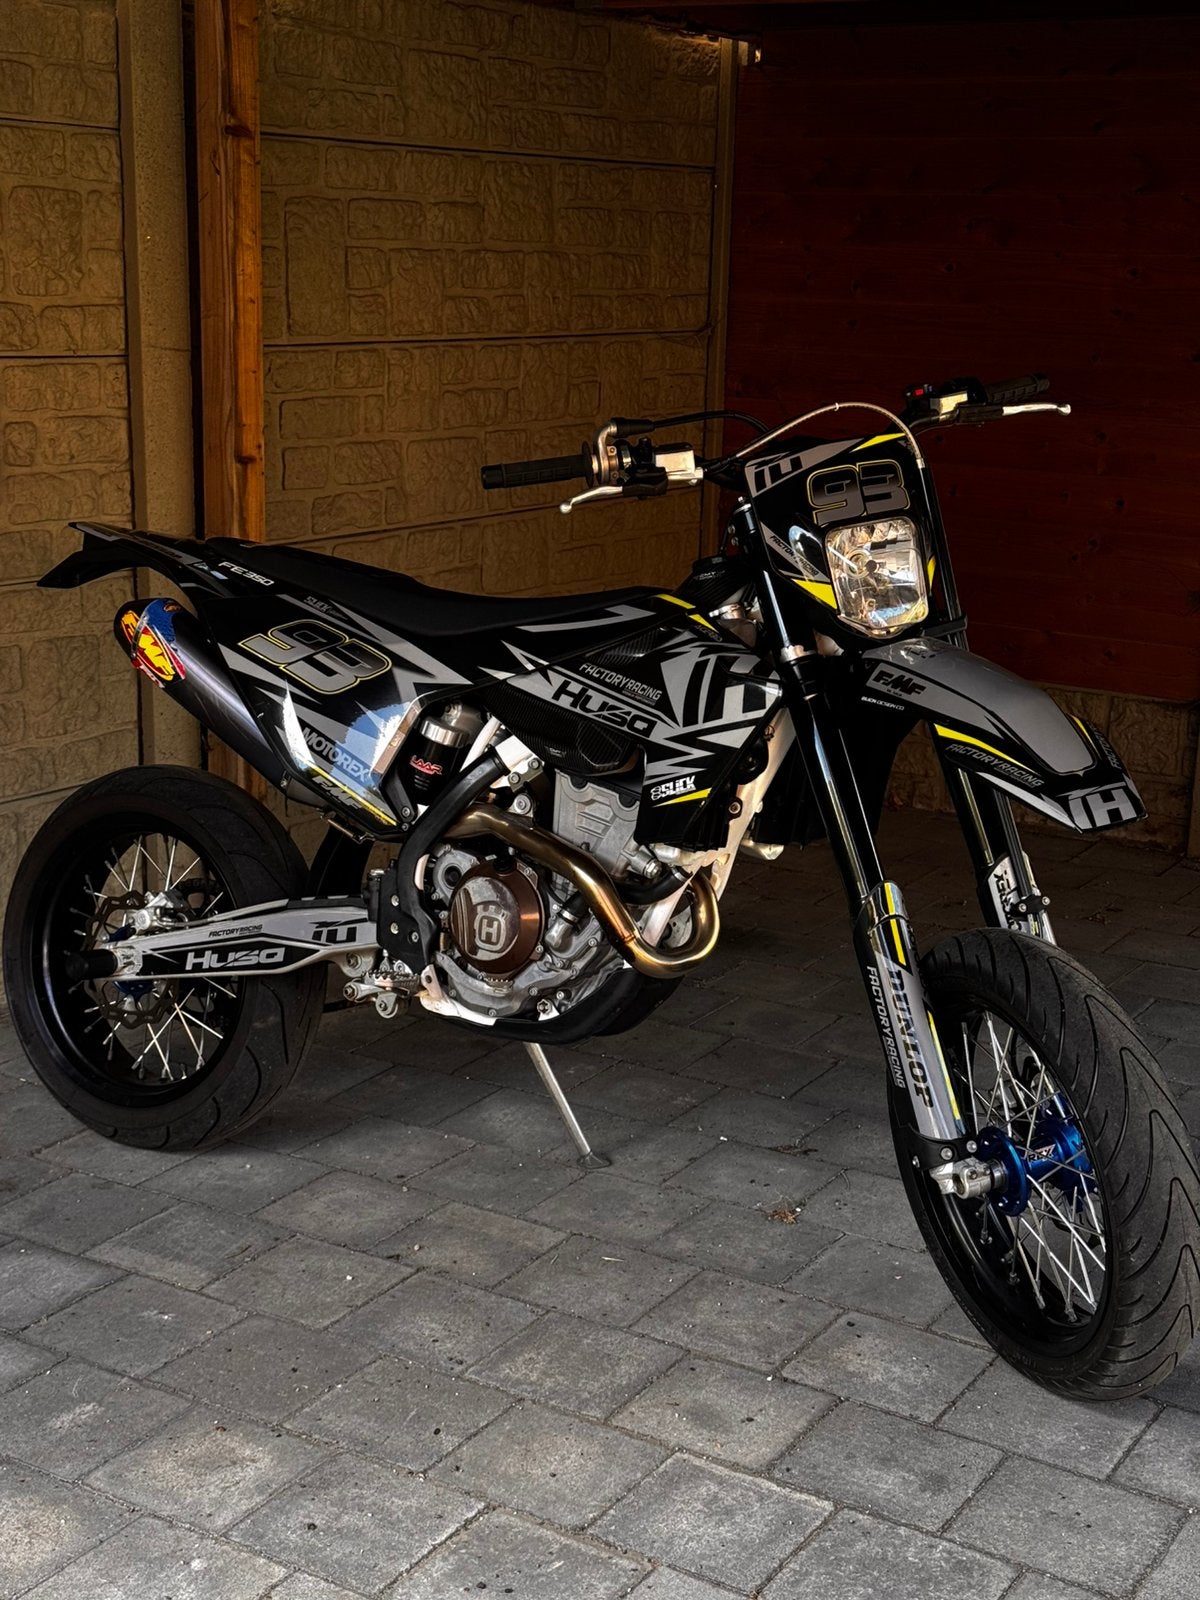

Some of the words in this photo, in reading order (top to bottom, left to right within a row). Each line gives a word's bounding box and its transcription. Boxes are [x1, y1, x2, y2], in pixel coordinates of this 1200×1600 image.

[806, 459, 911, 528] 93
[218, 561, 275, 586] FE350
[238, 619, 392, 695] 93
[873, 670, 927, 695] FMF
[302, 727, 372, 783] MOTOREX
[886, 967, 934, 1109] DUNLOP
